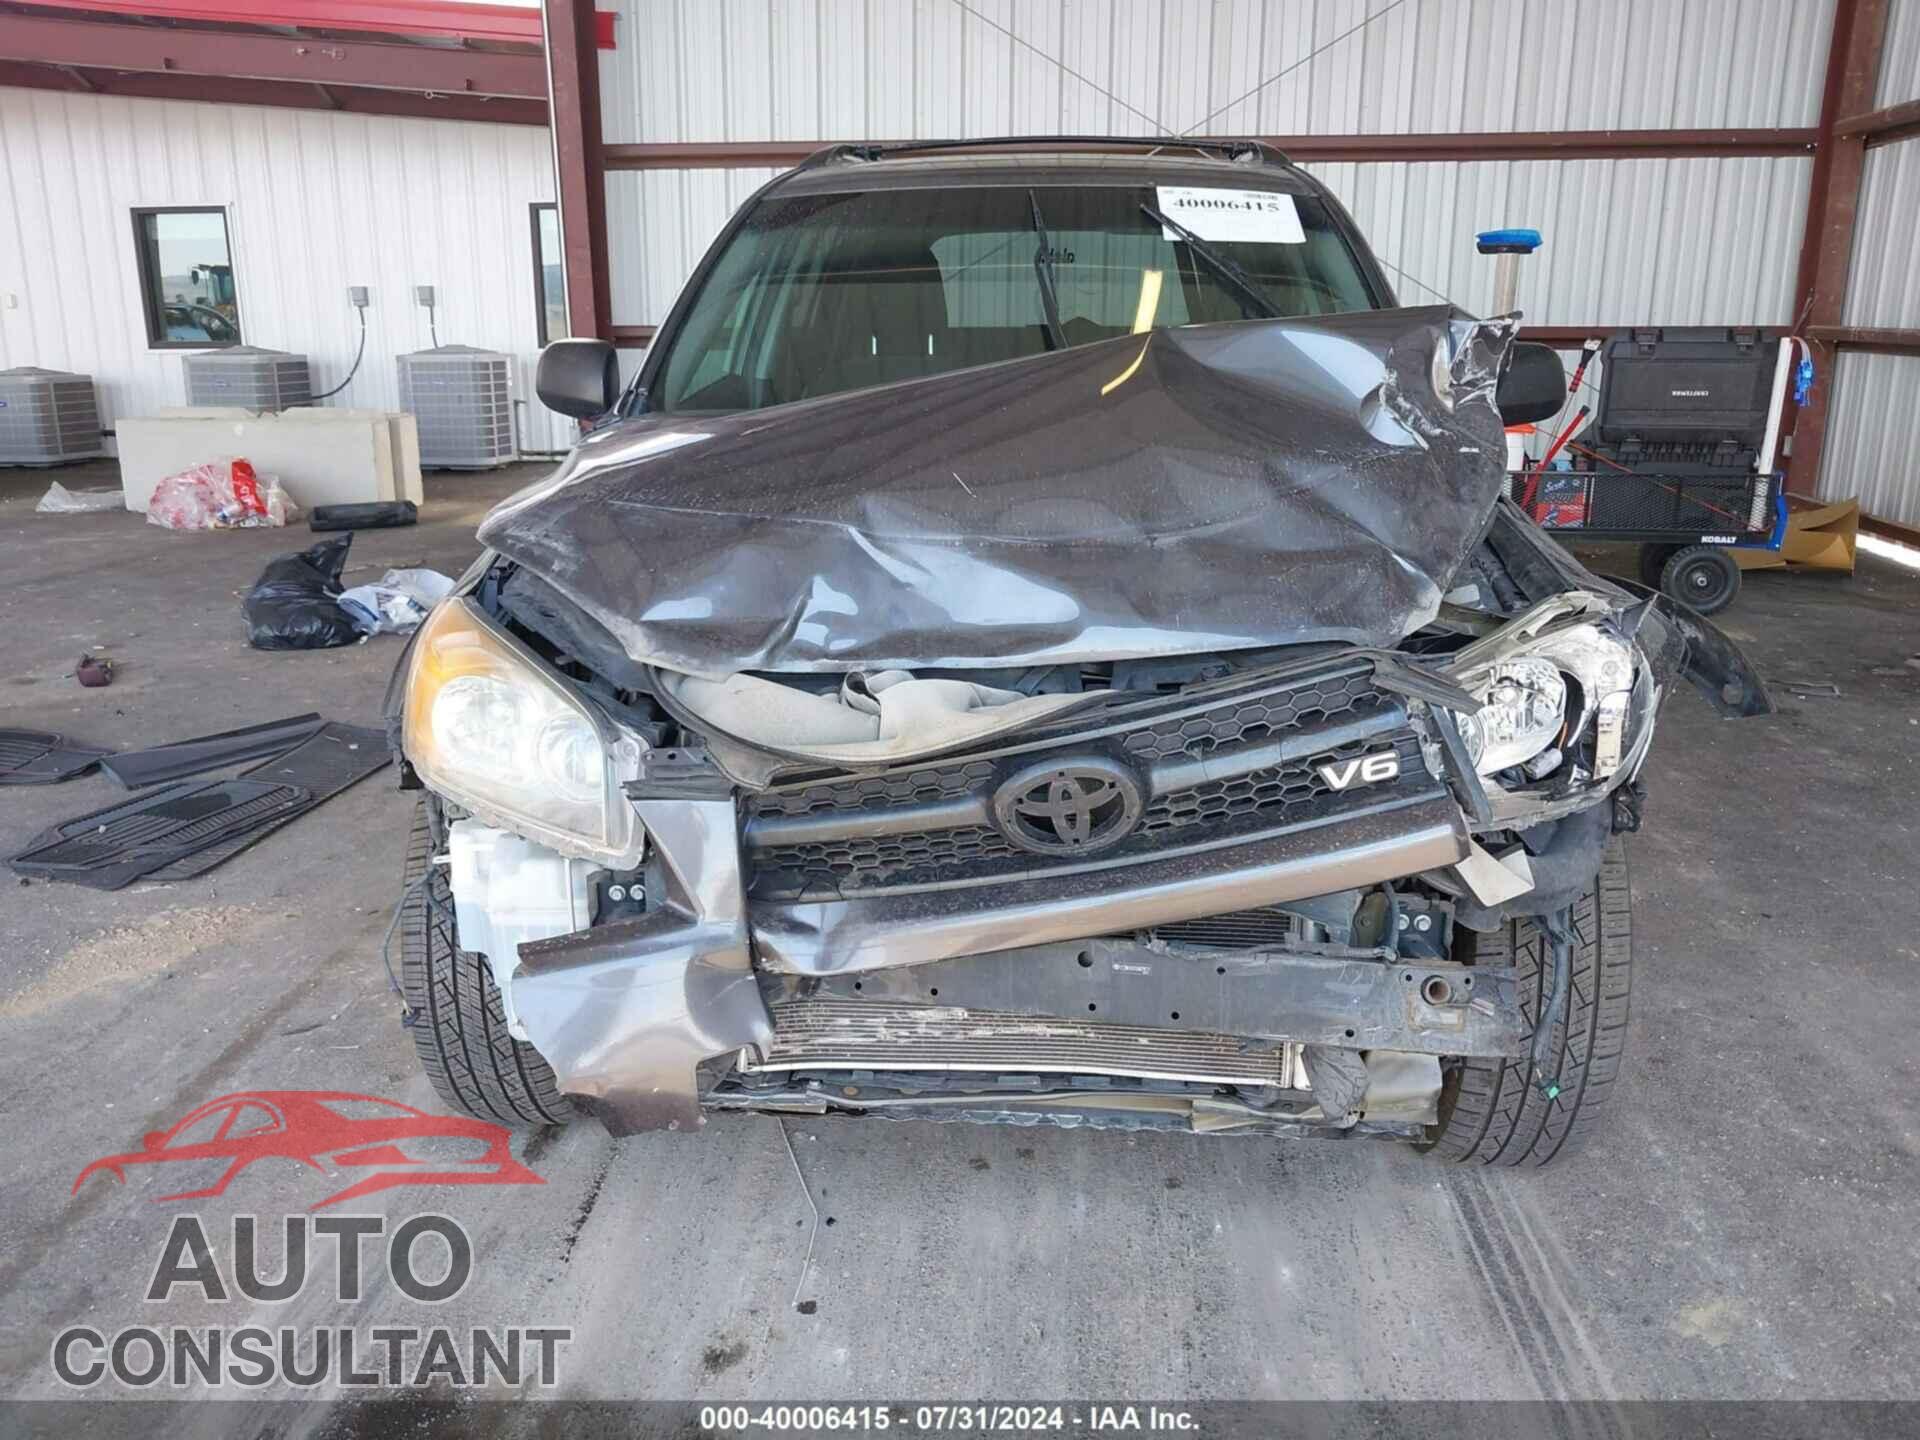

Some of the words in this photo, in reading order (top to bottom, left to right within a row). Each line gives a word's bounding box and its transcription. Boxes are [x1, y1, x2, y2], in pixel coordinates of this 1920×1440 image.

[1173, 198, 1280, 213] 40006415
[1700, 535, 1737, 544] KOBALT
[1318, 751, 1399, 790] V6
